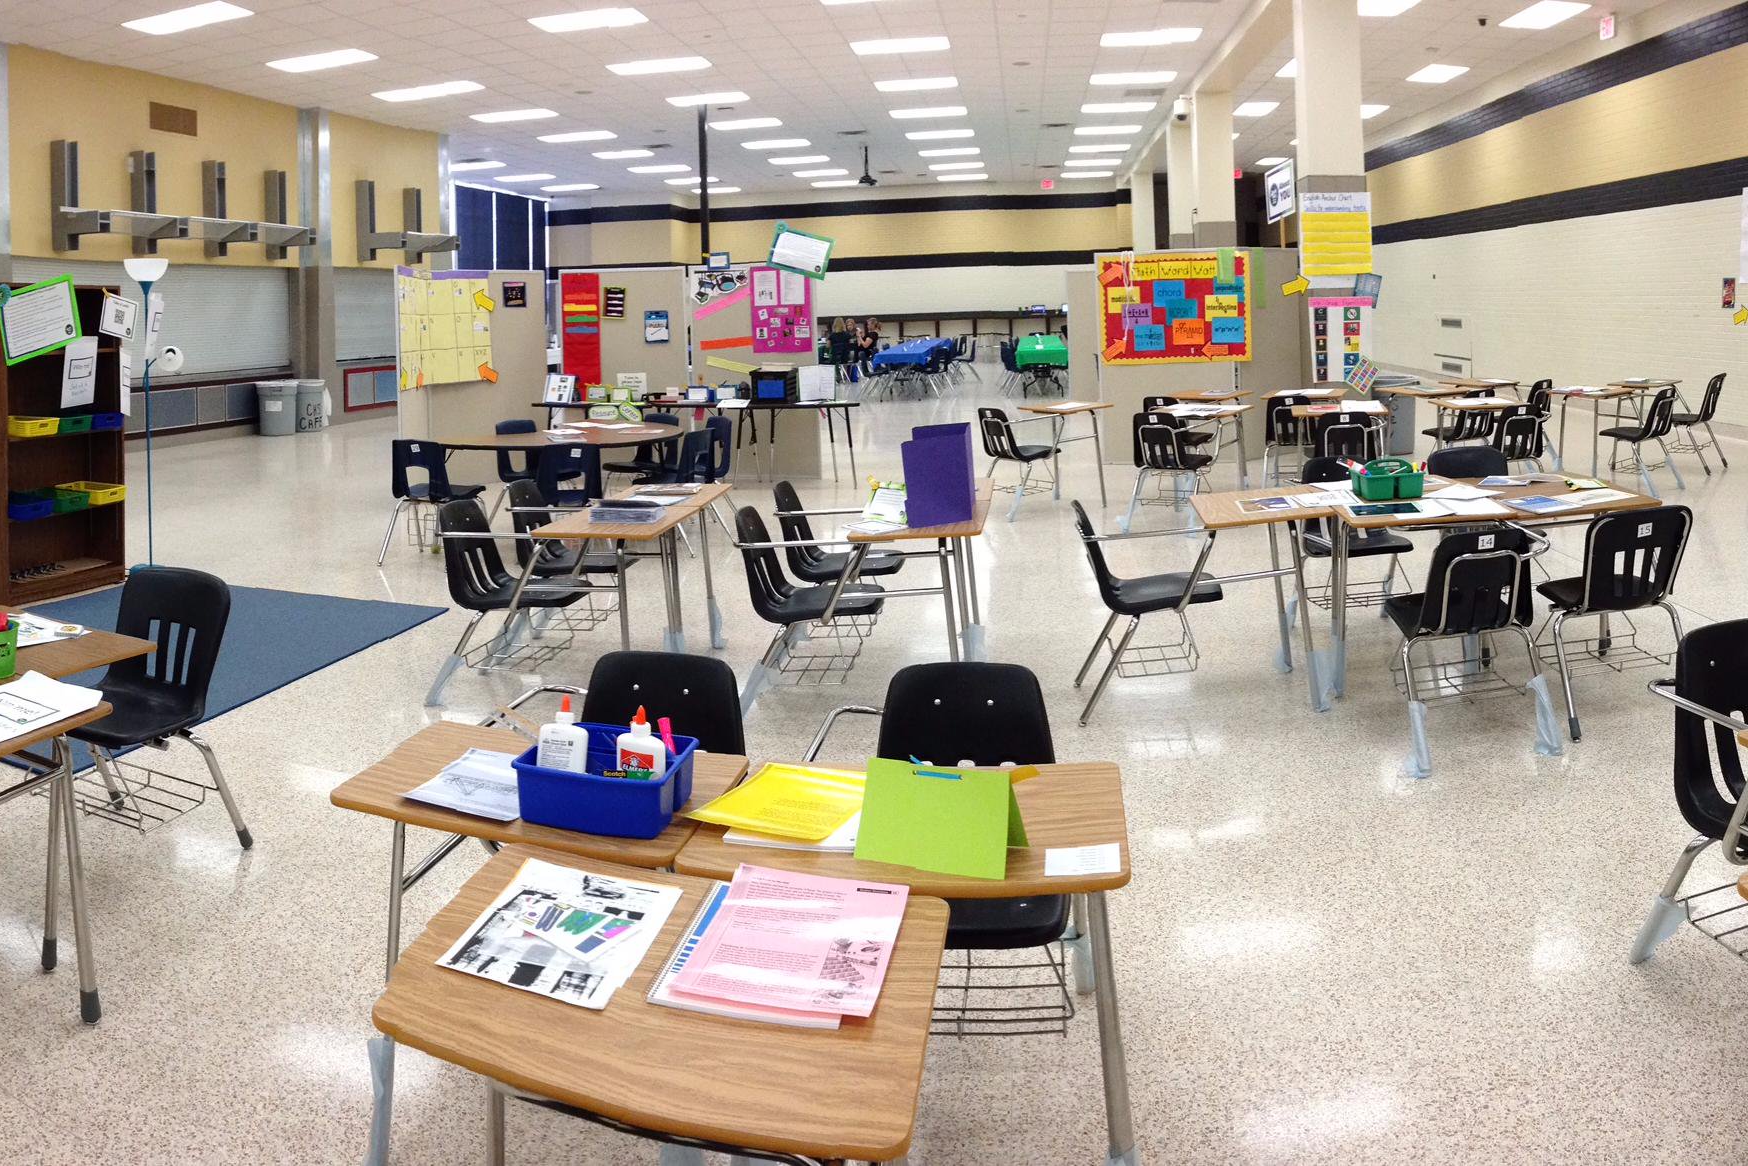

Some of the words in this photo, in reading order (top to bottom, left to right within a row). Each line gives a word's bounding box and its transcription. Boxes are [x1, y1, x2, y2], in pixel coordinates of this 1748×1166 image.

[1161, 266, 1190, 276] Word
[1640, 525, 1651, 535] 15
[1480, 537, 1493, 548] 14
